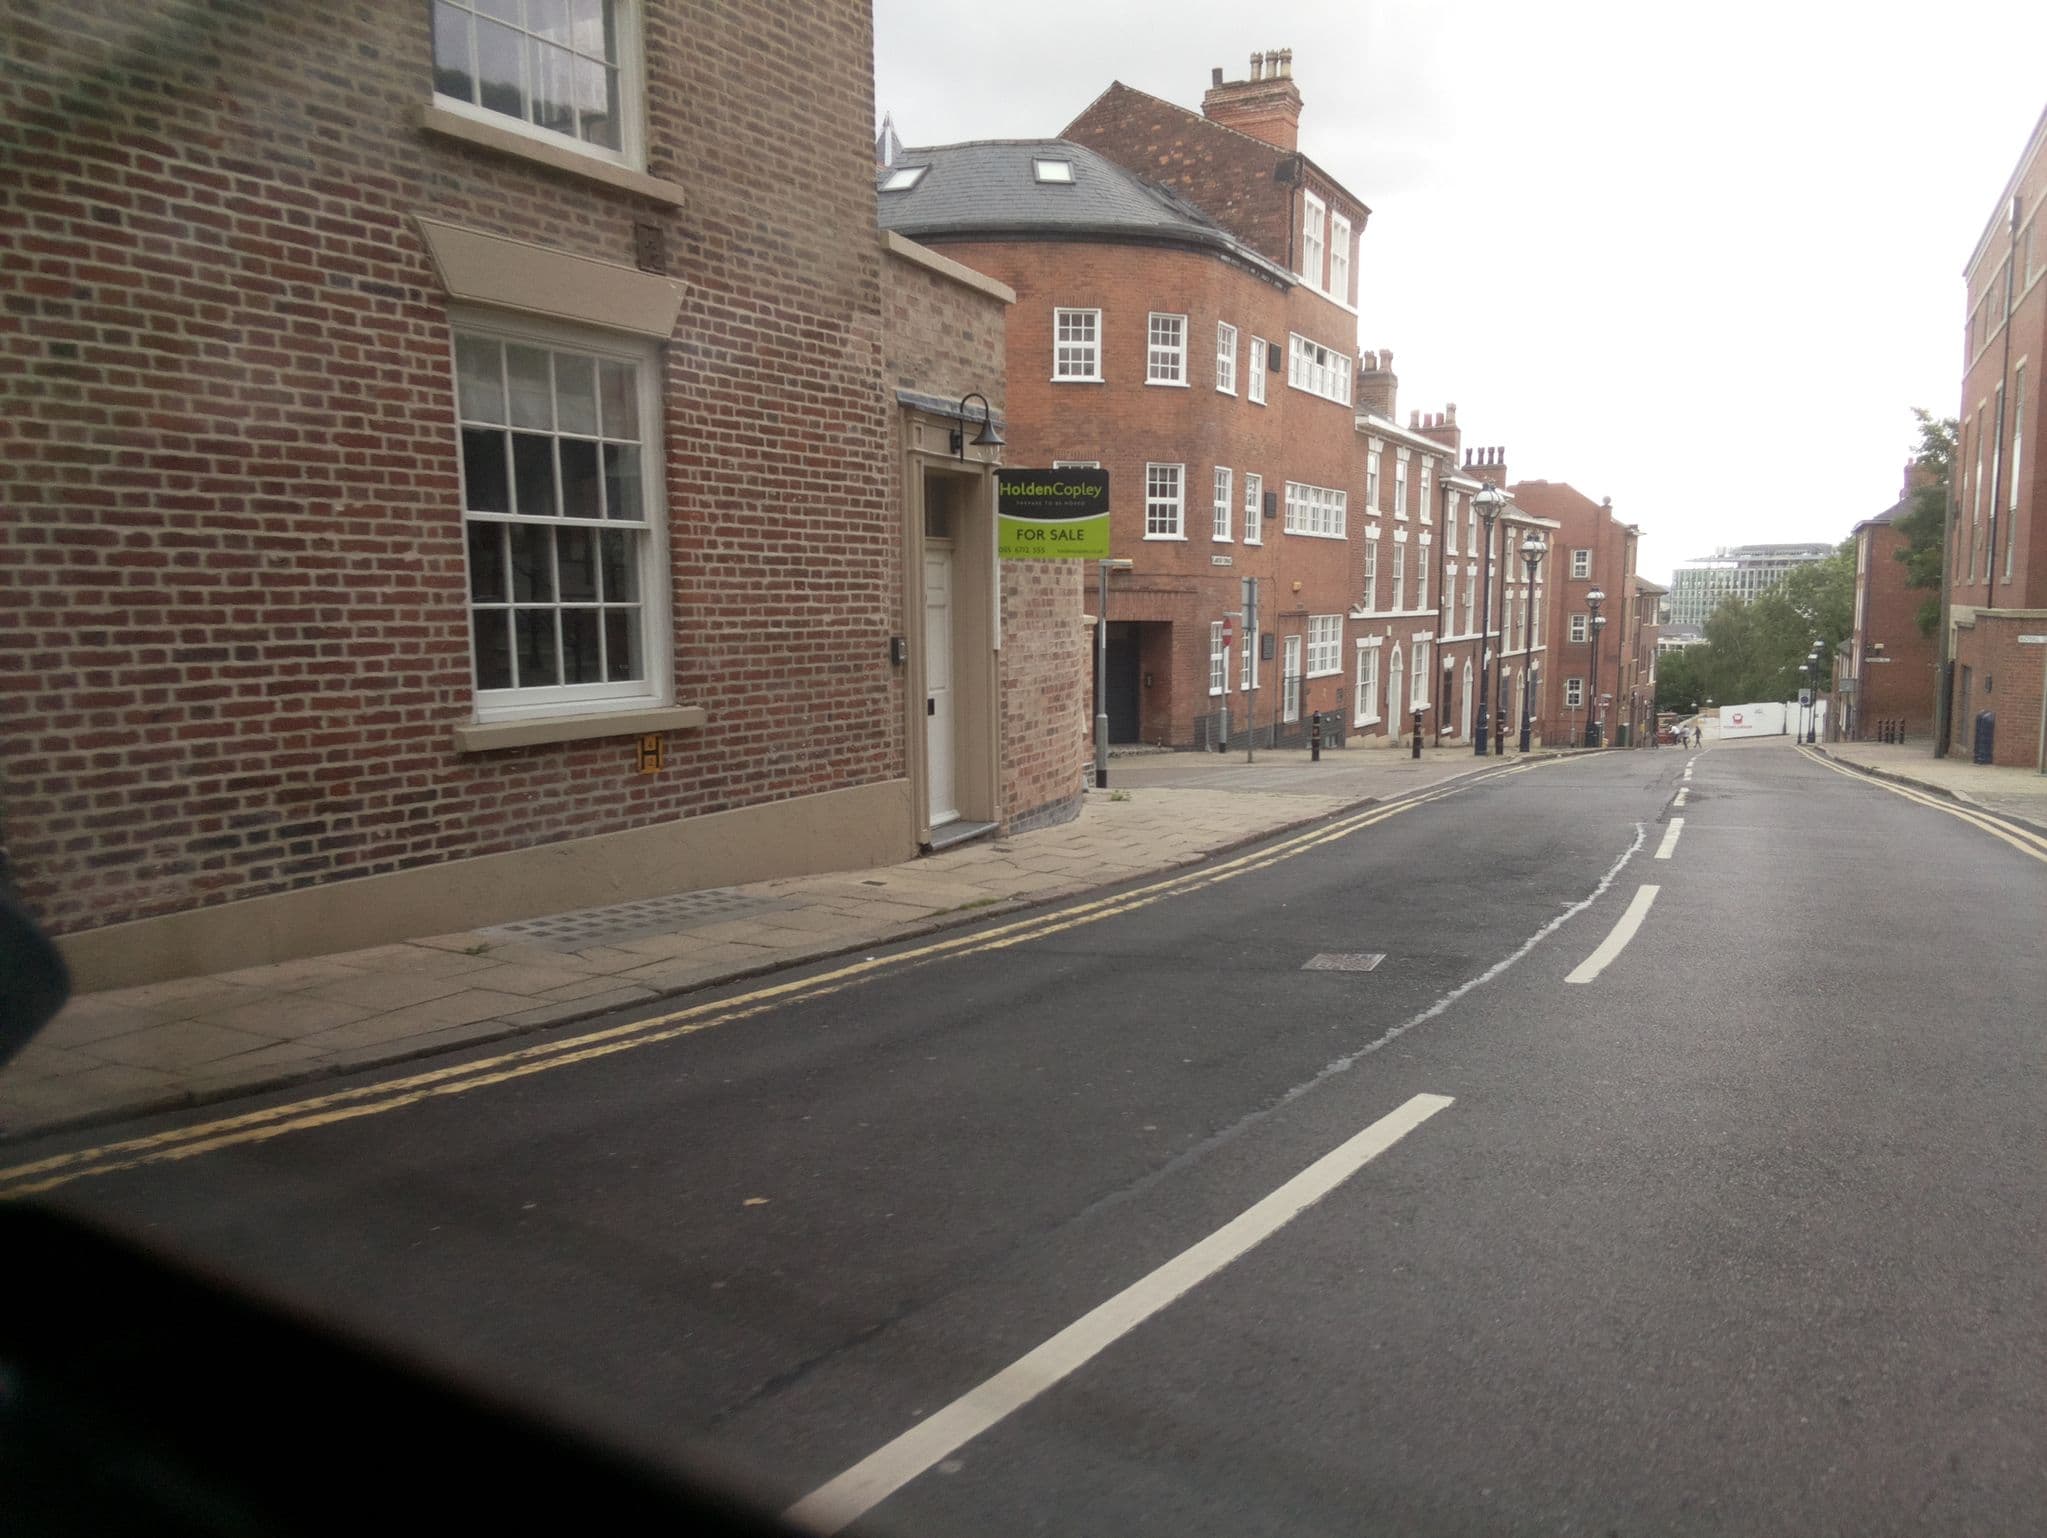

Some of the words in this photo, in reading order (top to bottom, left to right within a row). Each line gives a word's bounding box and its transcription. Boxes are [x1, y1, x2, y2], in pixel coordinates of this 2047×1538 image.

[1000, 482, 1102, 499] HoldenCopley
[1017, 529, 1046, 541] FOR
[1050, 529, 1084, 541] SALE
[641, 736, 660, 770] H
